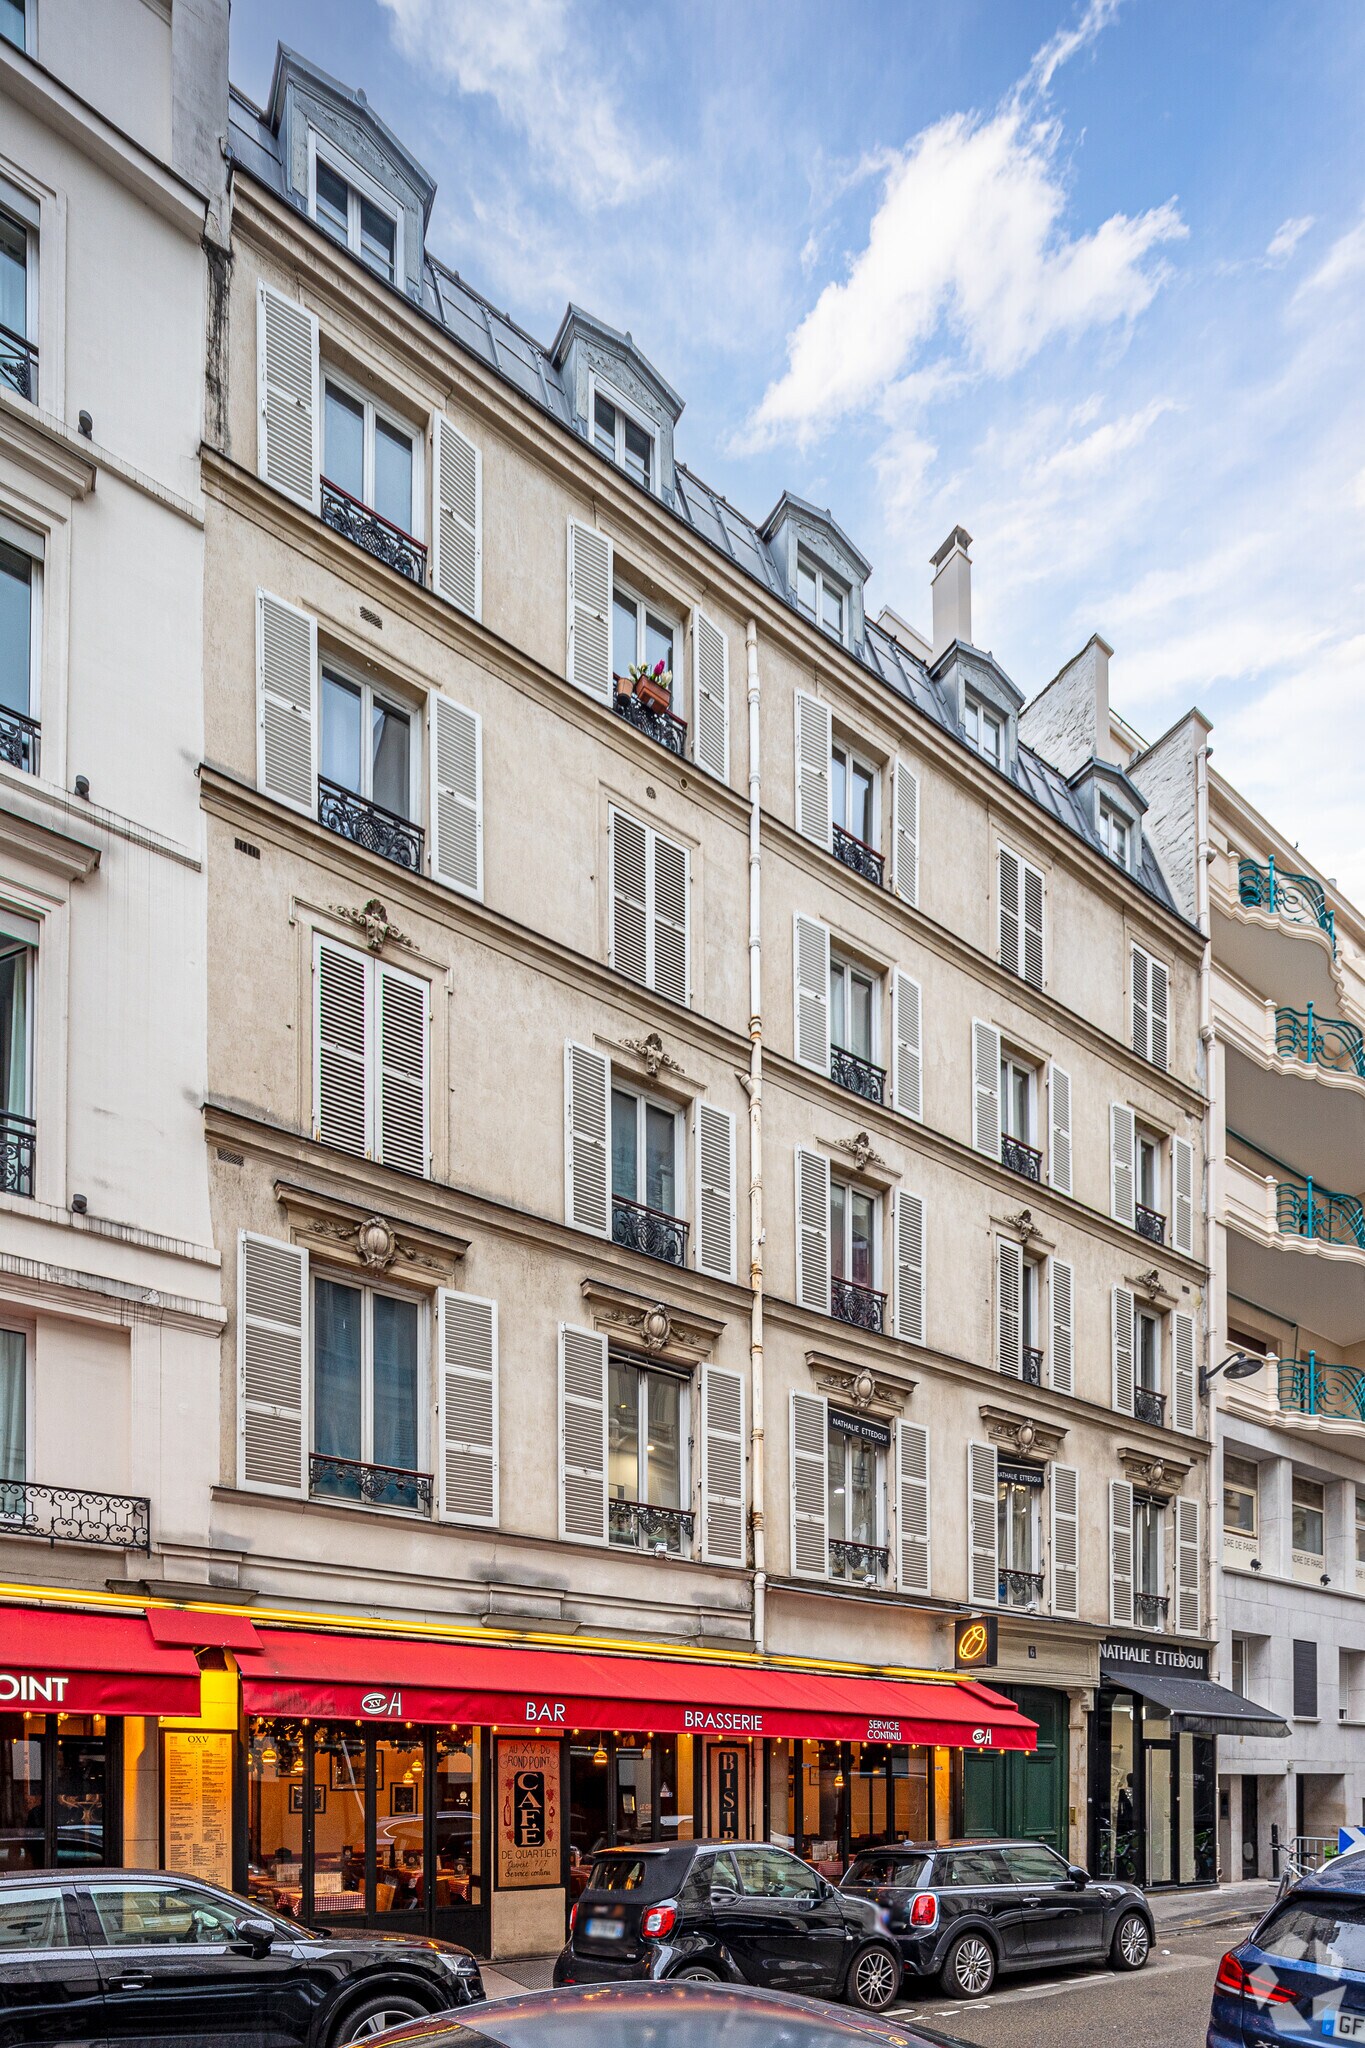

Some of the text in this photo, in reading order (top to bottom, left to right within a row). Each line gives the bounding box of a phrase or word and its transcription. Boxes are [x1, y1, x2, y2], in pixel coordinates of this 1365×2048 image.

[832, 1418, 887, 1442] NATHALIE ETTEDGUI
[1099, 1643, 1204, 1670] NATHALIE ETTEDGUI
[0, 1674, 69, 1702] OINT
[526, 1701, 566, 1722] BAR
[684, 1710, 763, 1731] BRASSERIE
[868, 1719, 900, 1731] SERVICE
[187, 1735, 209, 1744] OXV
[867, 1729, 902, 1741] CONTINU
[508, 1745, 518, 1754] AU
[521, 1742, 536, 1754] XV
[528, 1756, 551, 1769] POINT
[501, 1848, 558, 1860] DE QUARTIER
[504, 1868, 528, 1878] Service
[1339, 2014, 1365, 2037] GF
